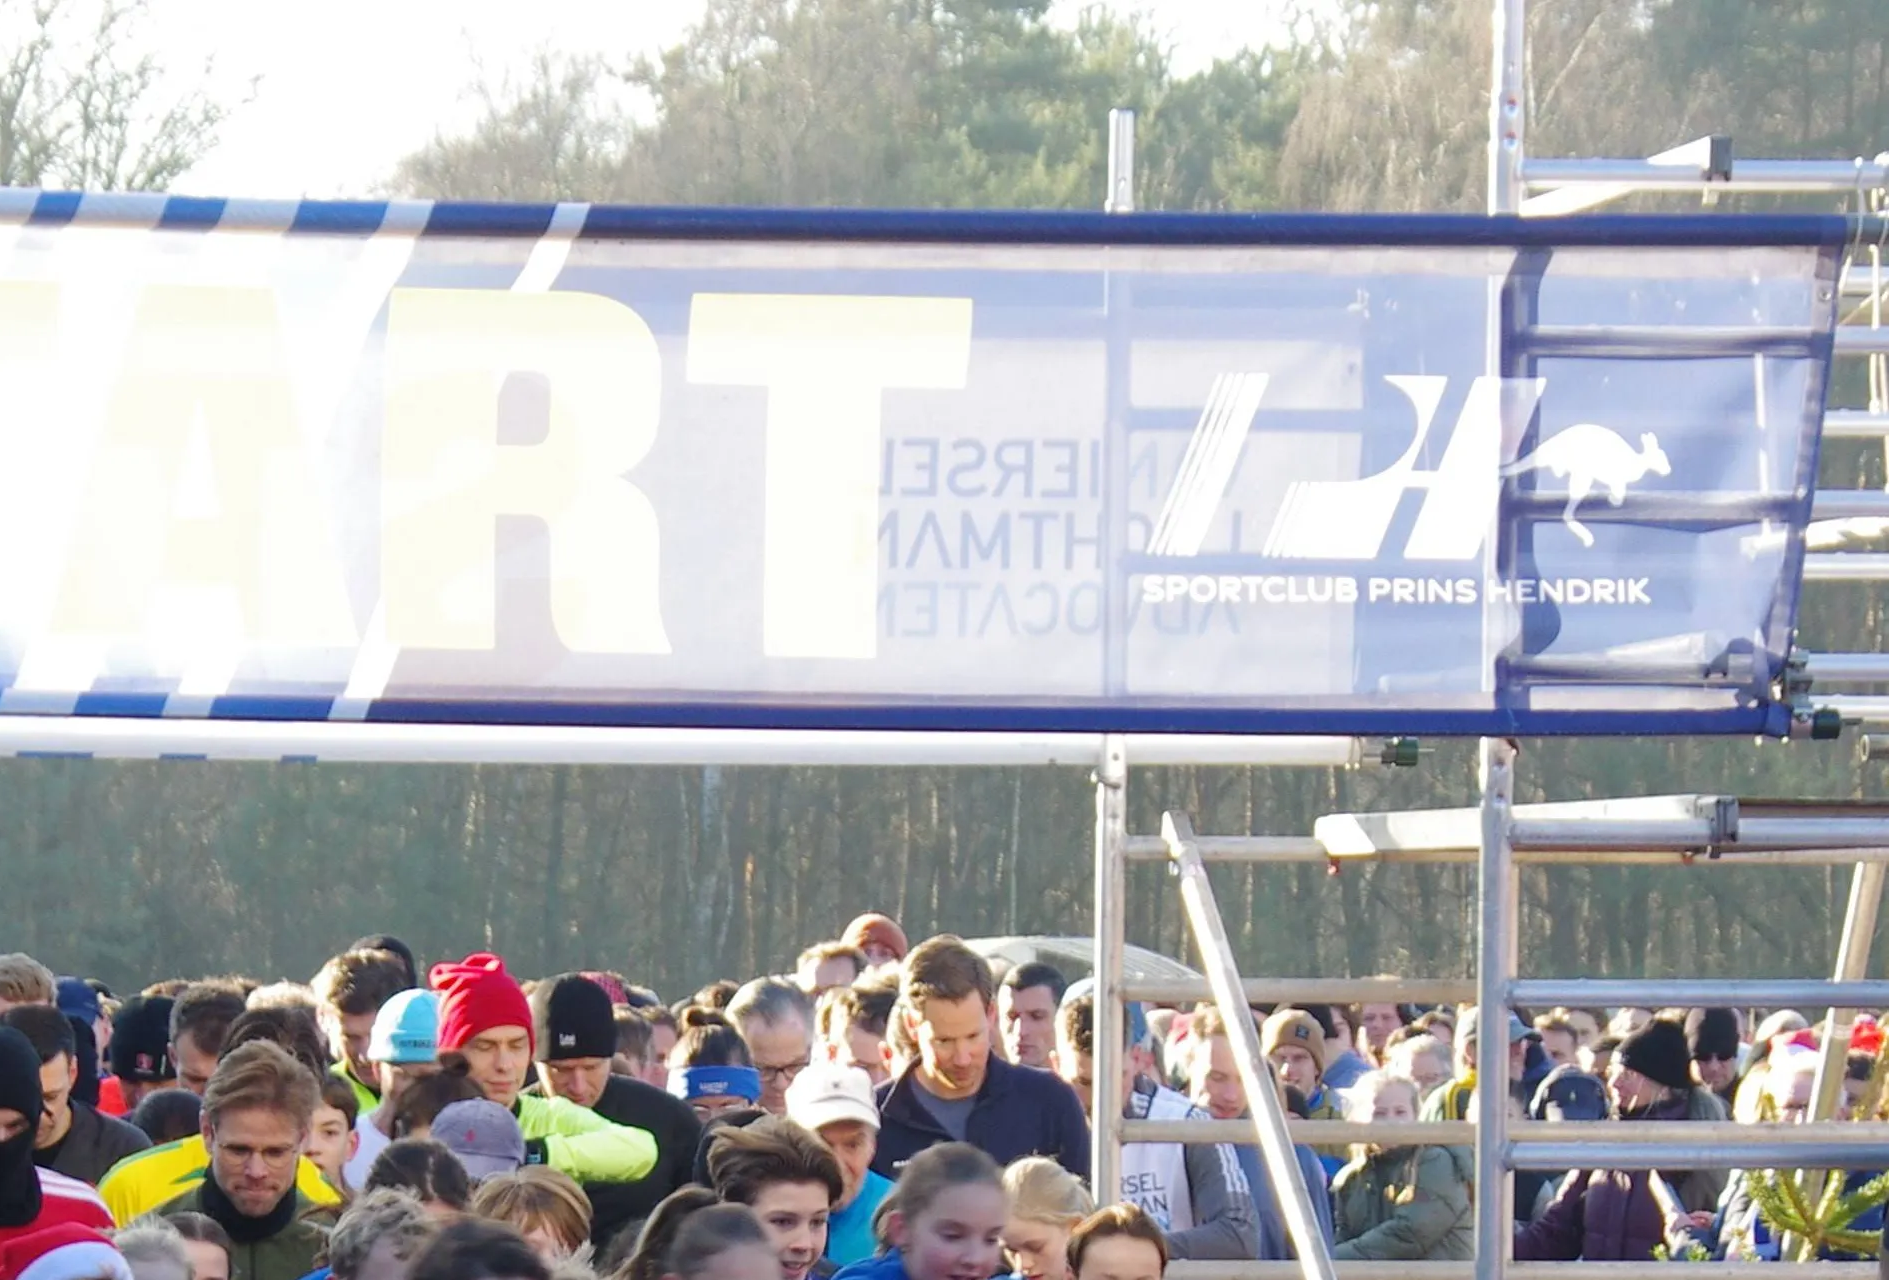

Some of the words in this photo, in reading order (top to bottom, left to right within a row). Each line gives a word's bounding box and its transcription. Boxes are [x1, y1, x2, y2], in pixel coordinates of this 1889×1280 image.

[1142, 575, 1358, 604] SPORTCLUB
[1369, 577, 1477, 604] PRINS
[1488, 577, 1652, 605] HENDRIK
